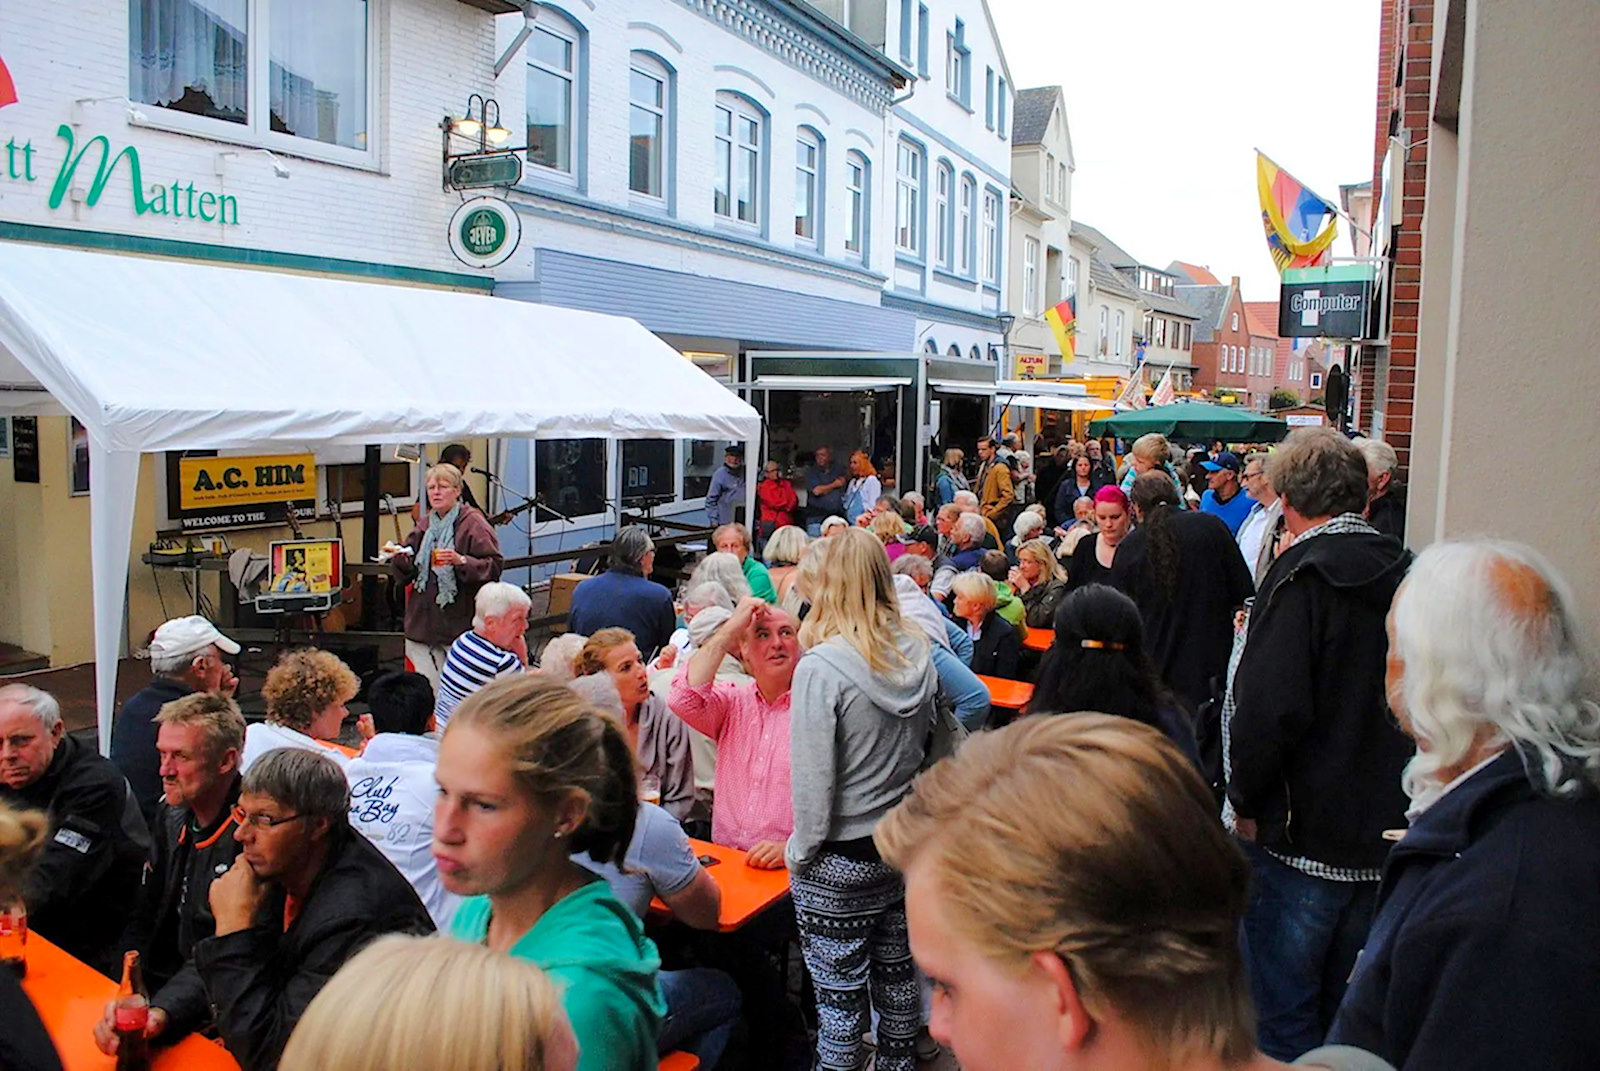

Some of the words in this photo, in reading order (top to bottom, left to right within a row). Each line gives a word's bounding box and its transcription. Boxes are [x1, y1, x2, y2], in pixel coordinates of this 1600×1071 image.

[0, 136, 37, 182] tt
[49, 124, 240, 225] Matten
[469, 226, 497, 246] JEVER
[1290, 293, 1361, 316] Computer
[193, 468, 249, 491] A.C.
[255, 464, 305, 487] HIM
[183, 514, 231, 528] WELCOME
[232, 513, 246, 524] TO
[247, 511, 266, 522] THE
[351, 775, 399, 799] Club
[359, 799, 400, 824] Bay
